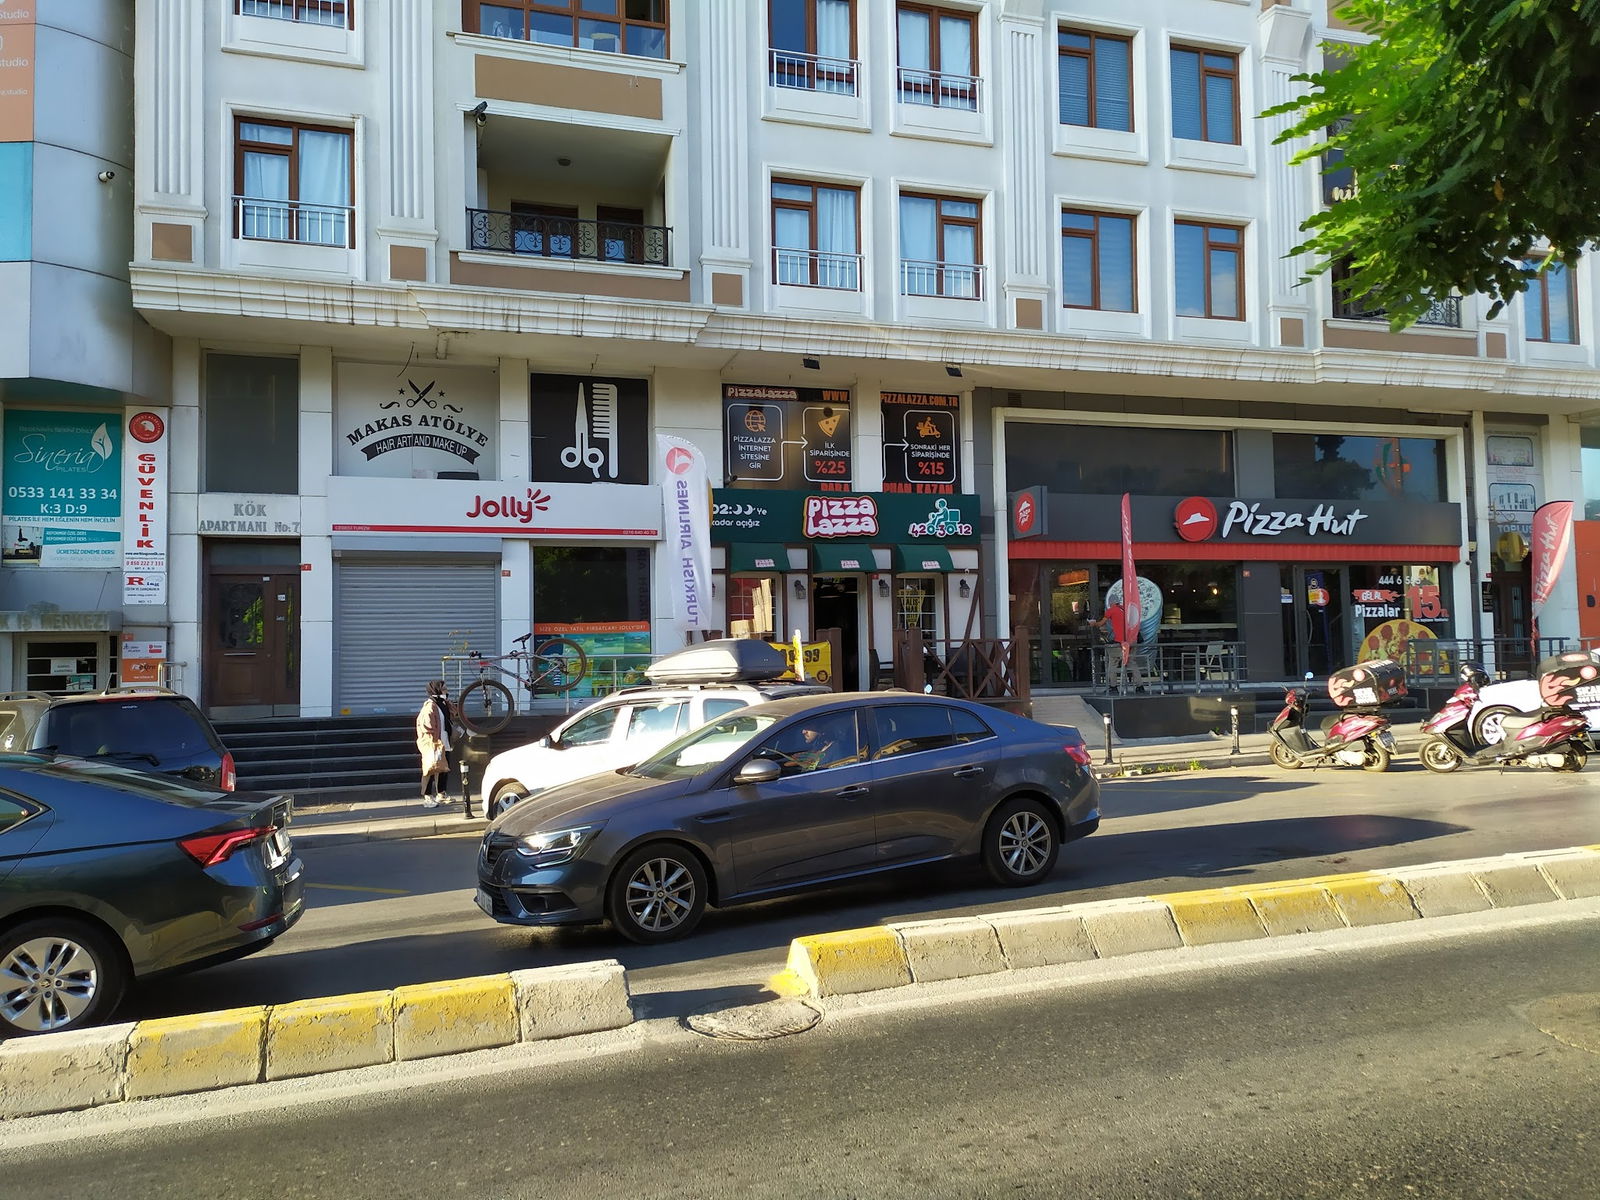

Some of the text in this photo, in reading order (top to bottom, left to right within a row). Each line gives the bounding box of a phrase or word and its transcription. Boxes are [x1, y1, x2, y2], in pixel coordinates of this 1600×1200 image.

[346, 415, 488, 447] MAKAS ATÖLYE
[376, 435, 467, 456] HAIR ART AND MAKE UP
[815, 460, 846, 474] %25
[918, 461, 945, 475] %15
[9, 487, 117, 499] 0533 141 33 34
[137, 453, 156, 548] GÜVENLİK
[41, 504, 87, 513] K:3 D:9
[234, 501, 266, 516] KÖK
[466, 495, 532, 523] Jolly
[198, 520, 267, 532] APARTMANI
[1222, 501, 1368, 538] Pizza Hut
[1379, 576, 1394, 584] 444
[1396, 576, 1402, 584] 6
[1407, 585, 1441, 618] 15
[1355, 604, 1400, 617] Pizzalar
